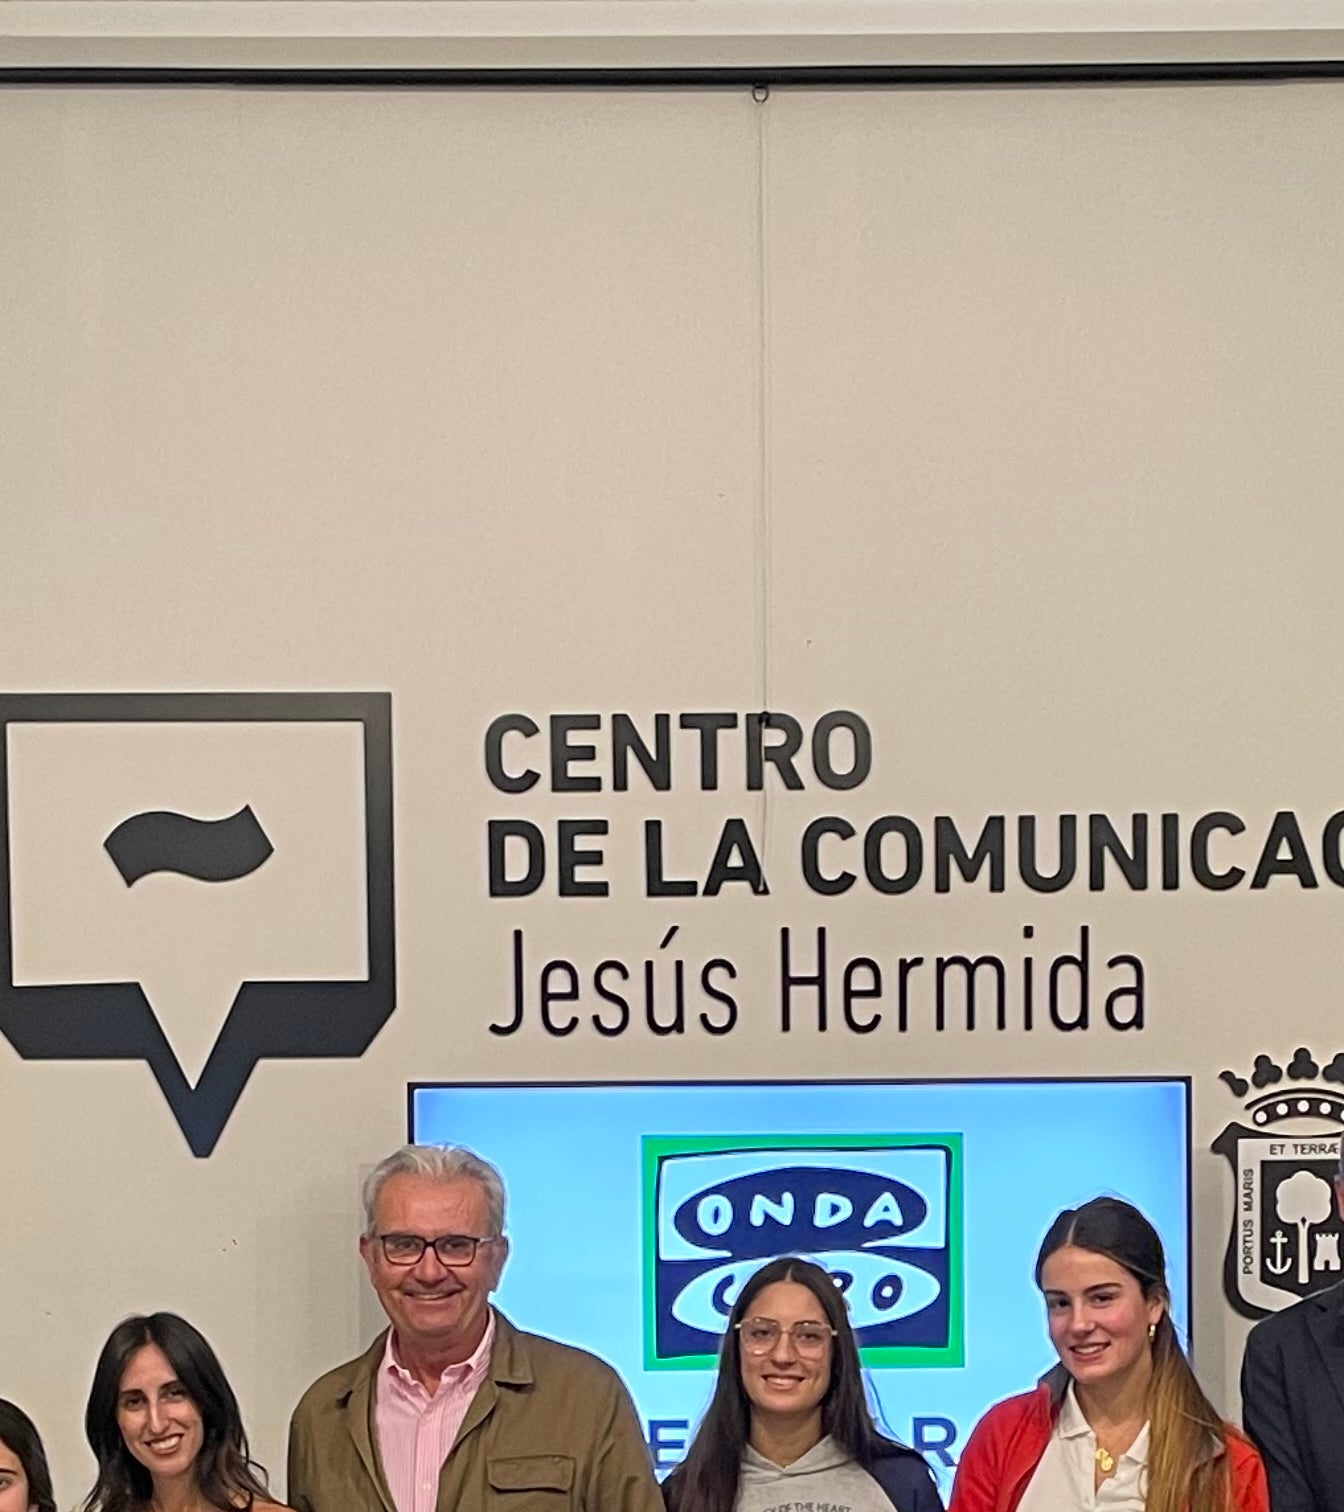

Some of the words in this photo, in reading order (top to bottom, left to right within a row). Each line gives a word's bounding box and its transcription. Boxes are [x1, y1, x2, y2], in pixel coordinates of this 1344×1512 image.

[483, 709, 873, 795] CENTRO
[486, 818, 611, 899] DE
[643, 817, 772, 898] LA
[487, 924, 739, 1039] Jesús
[779, 924, 1146, 1036] Hermida
[1269, 1143, 1286, 1155] ET
[696, 1191, 904, 1237] ONDA
[1242, 1168, 1254, 1212] MARIS
[1242, 1219, 1254, 1274] PORTUS
[794, 1502, 815, 1512] THE
